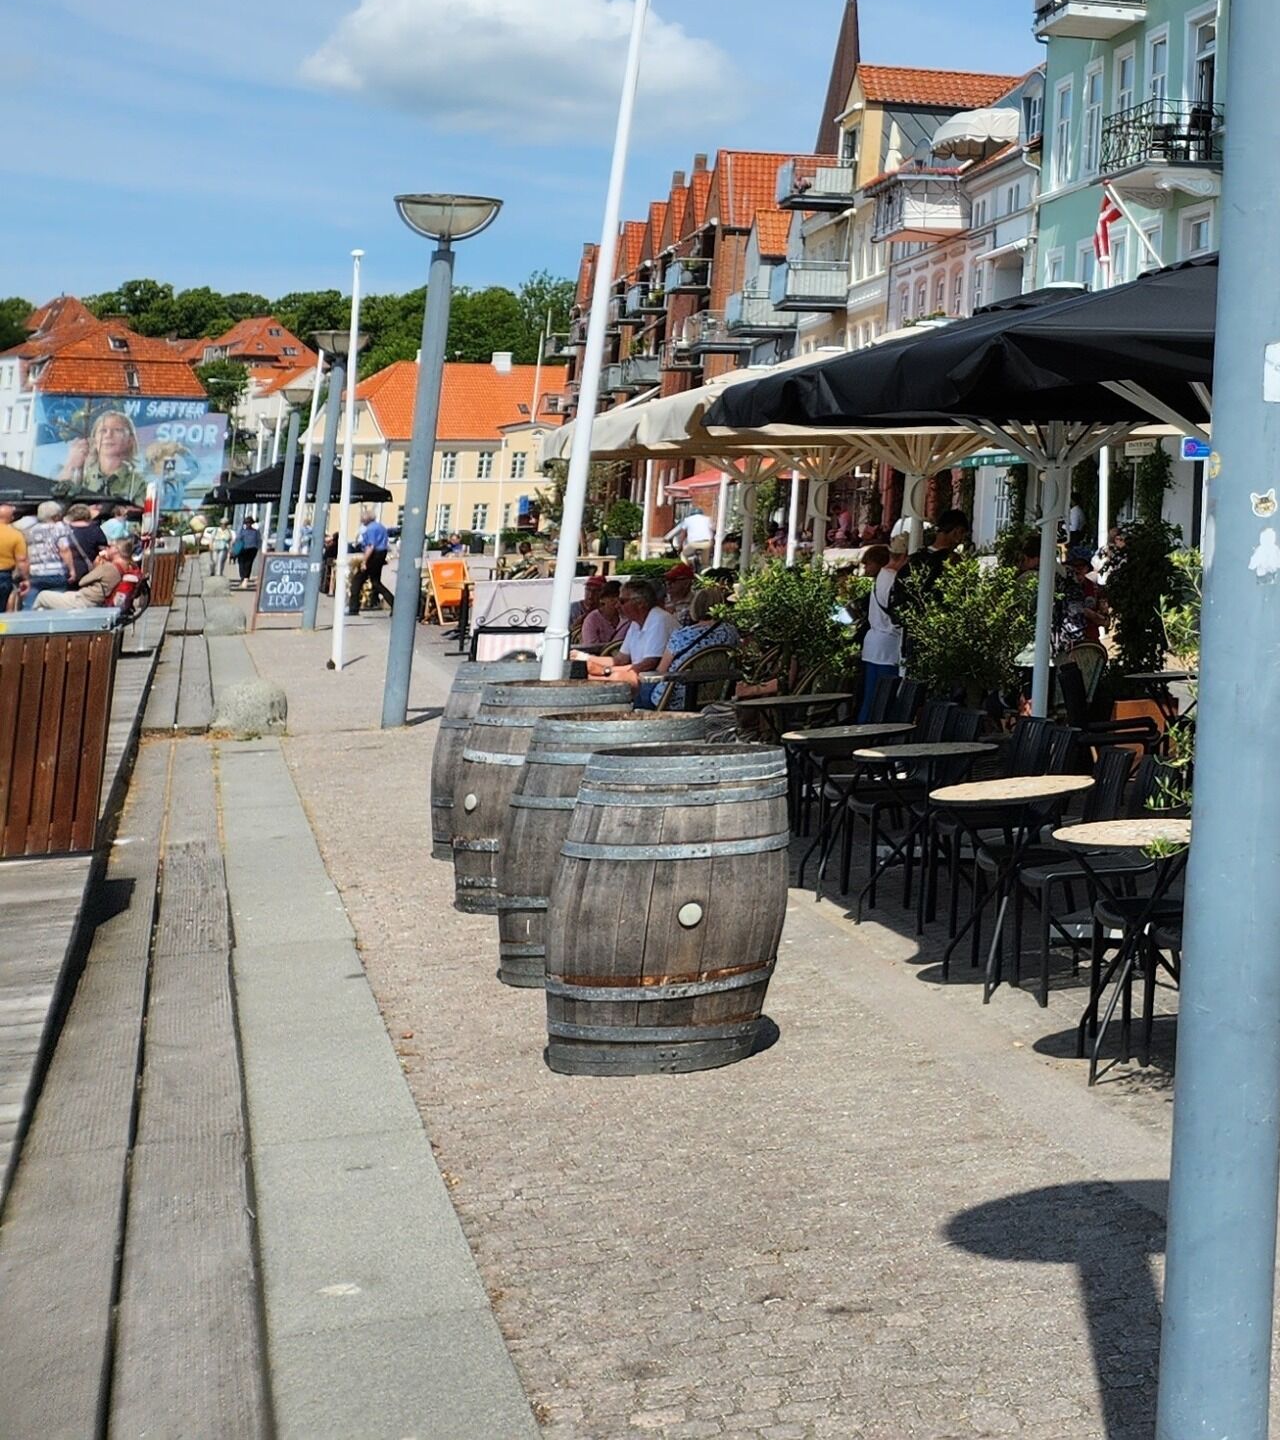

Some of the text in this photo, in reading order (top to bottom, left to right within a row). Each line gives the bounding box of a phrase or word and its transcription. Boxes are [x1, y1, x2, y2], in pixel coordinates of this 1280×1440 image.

[124, 401, 205, 417] VI SÆTTER
[156, 423, 218, 446] SPOR
[266, 581, 304, 595] GOOD
[268, 595, 298, 607] IDEA
